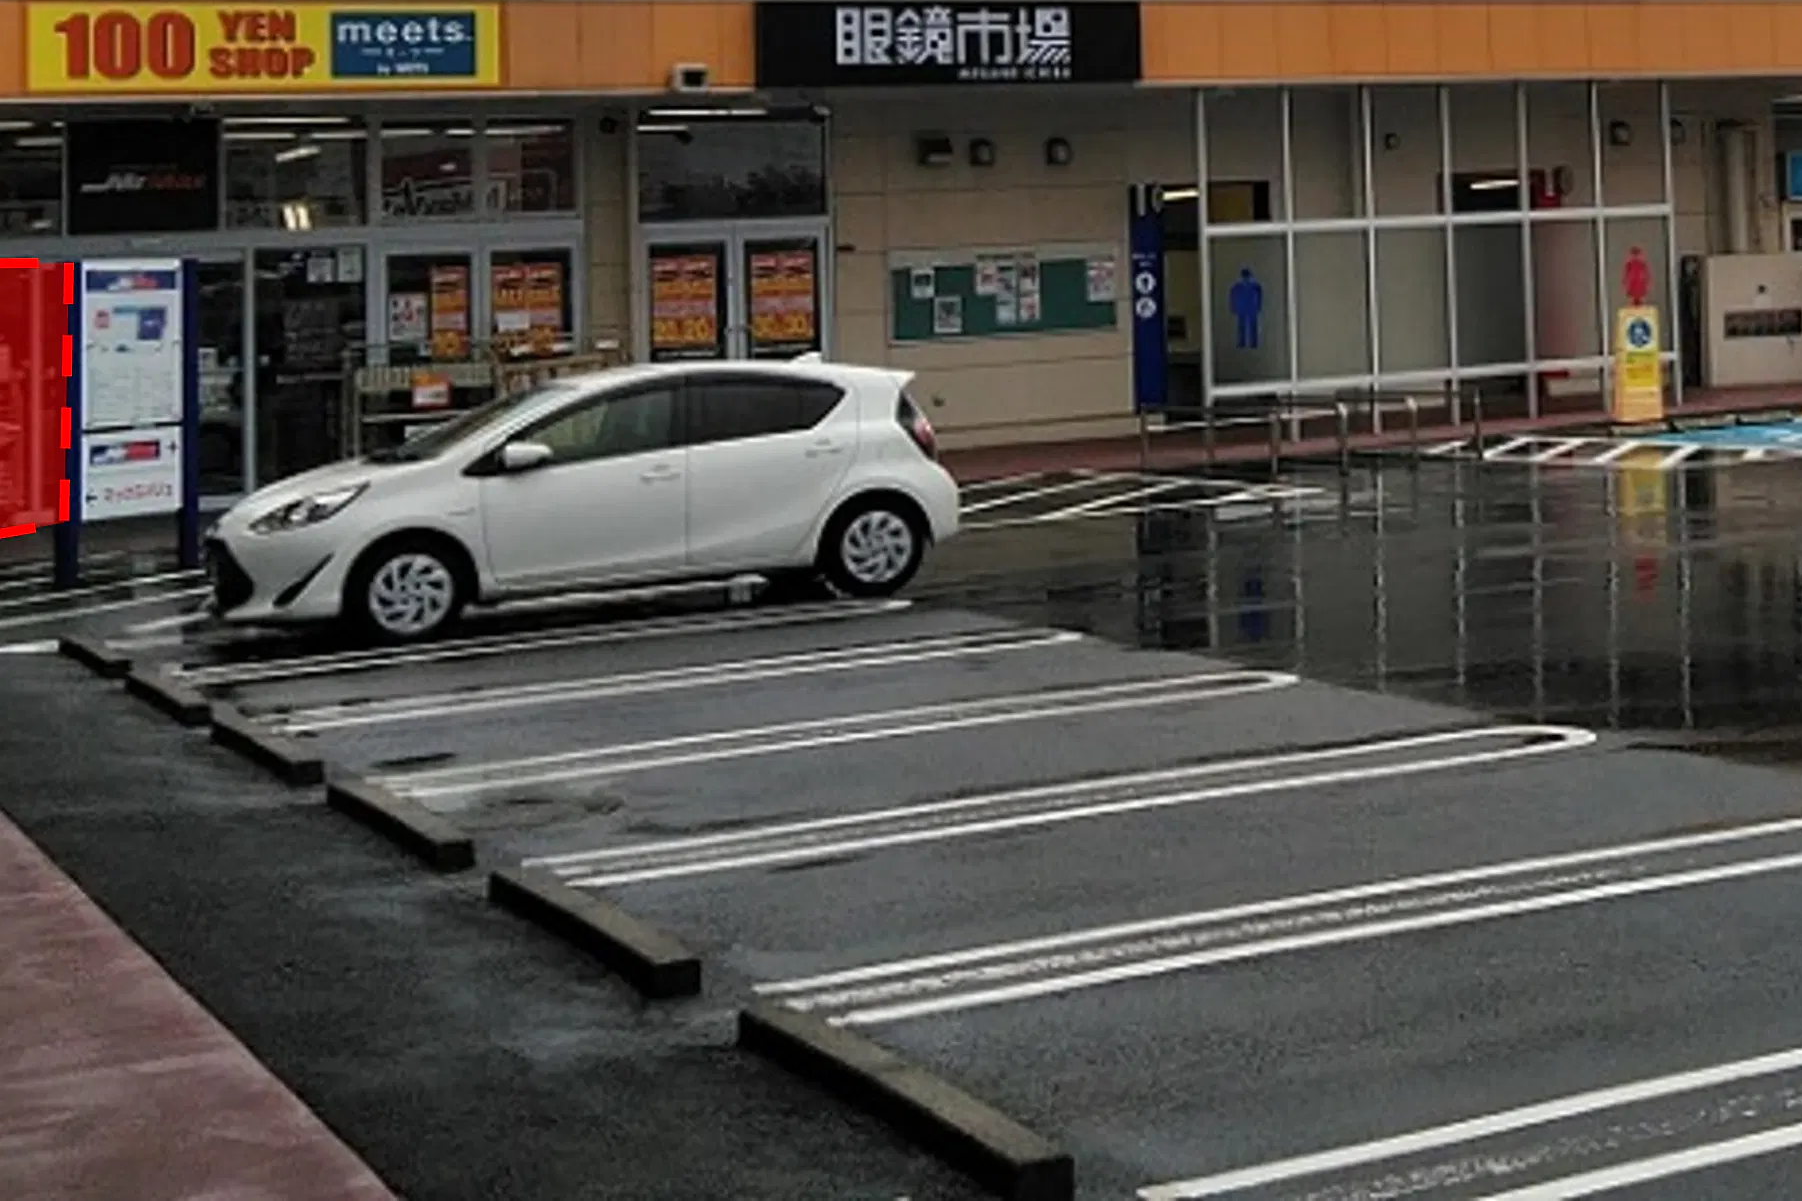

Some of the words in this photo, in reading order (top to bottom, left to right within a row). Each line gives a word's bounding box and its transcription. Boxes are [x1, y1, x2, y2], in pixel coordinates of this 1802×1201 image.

[54, 11, 195, 80] 100
[217, 11, 296, 43] YEN
[208, 46, 316, 79] SHOP
[836, 5, 1071, 64] 眼鏡市場
